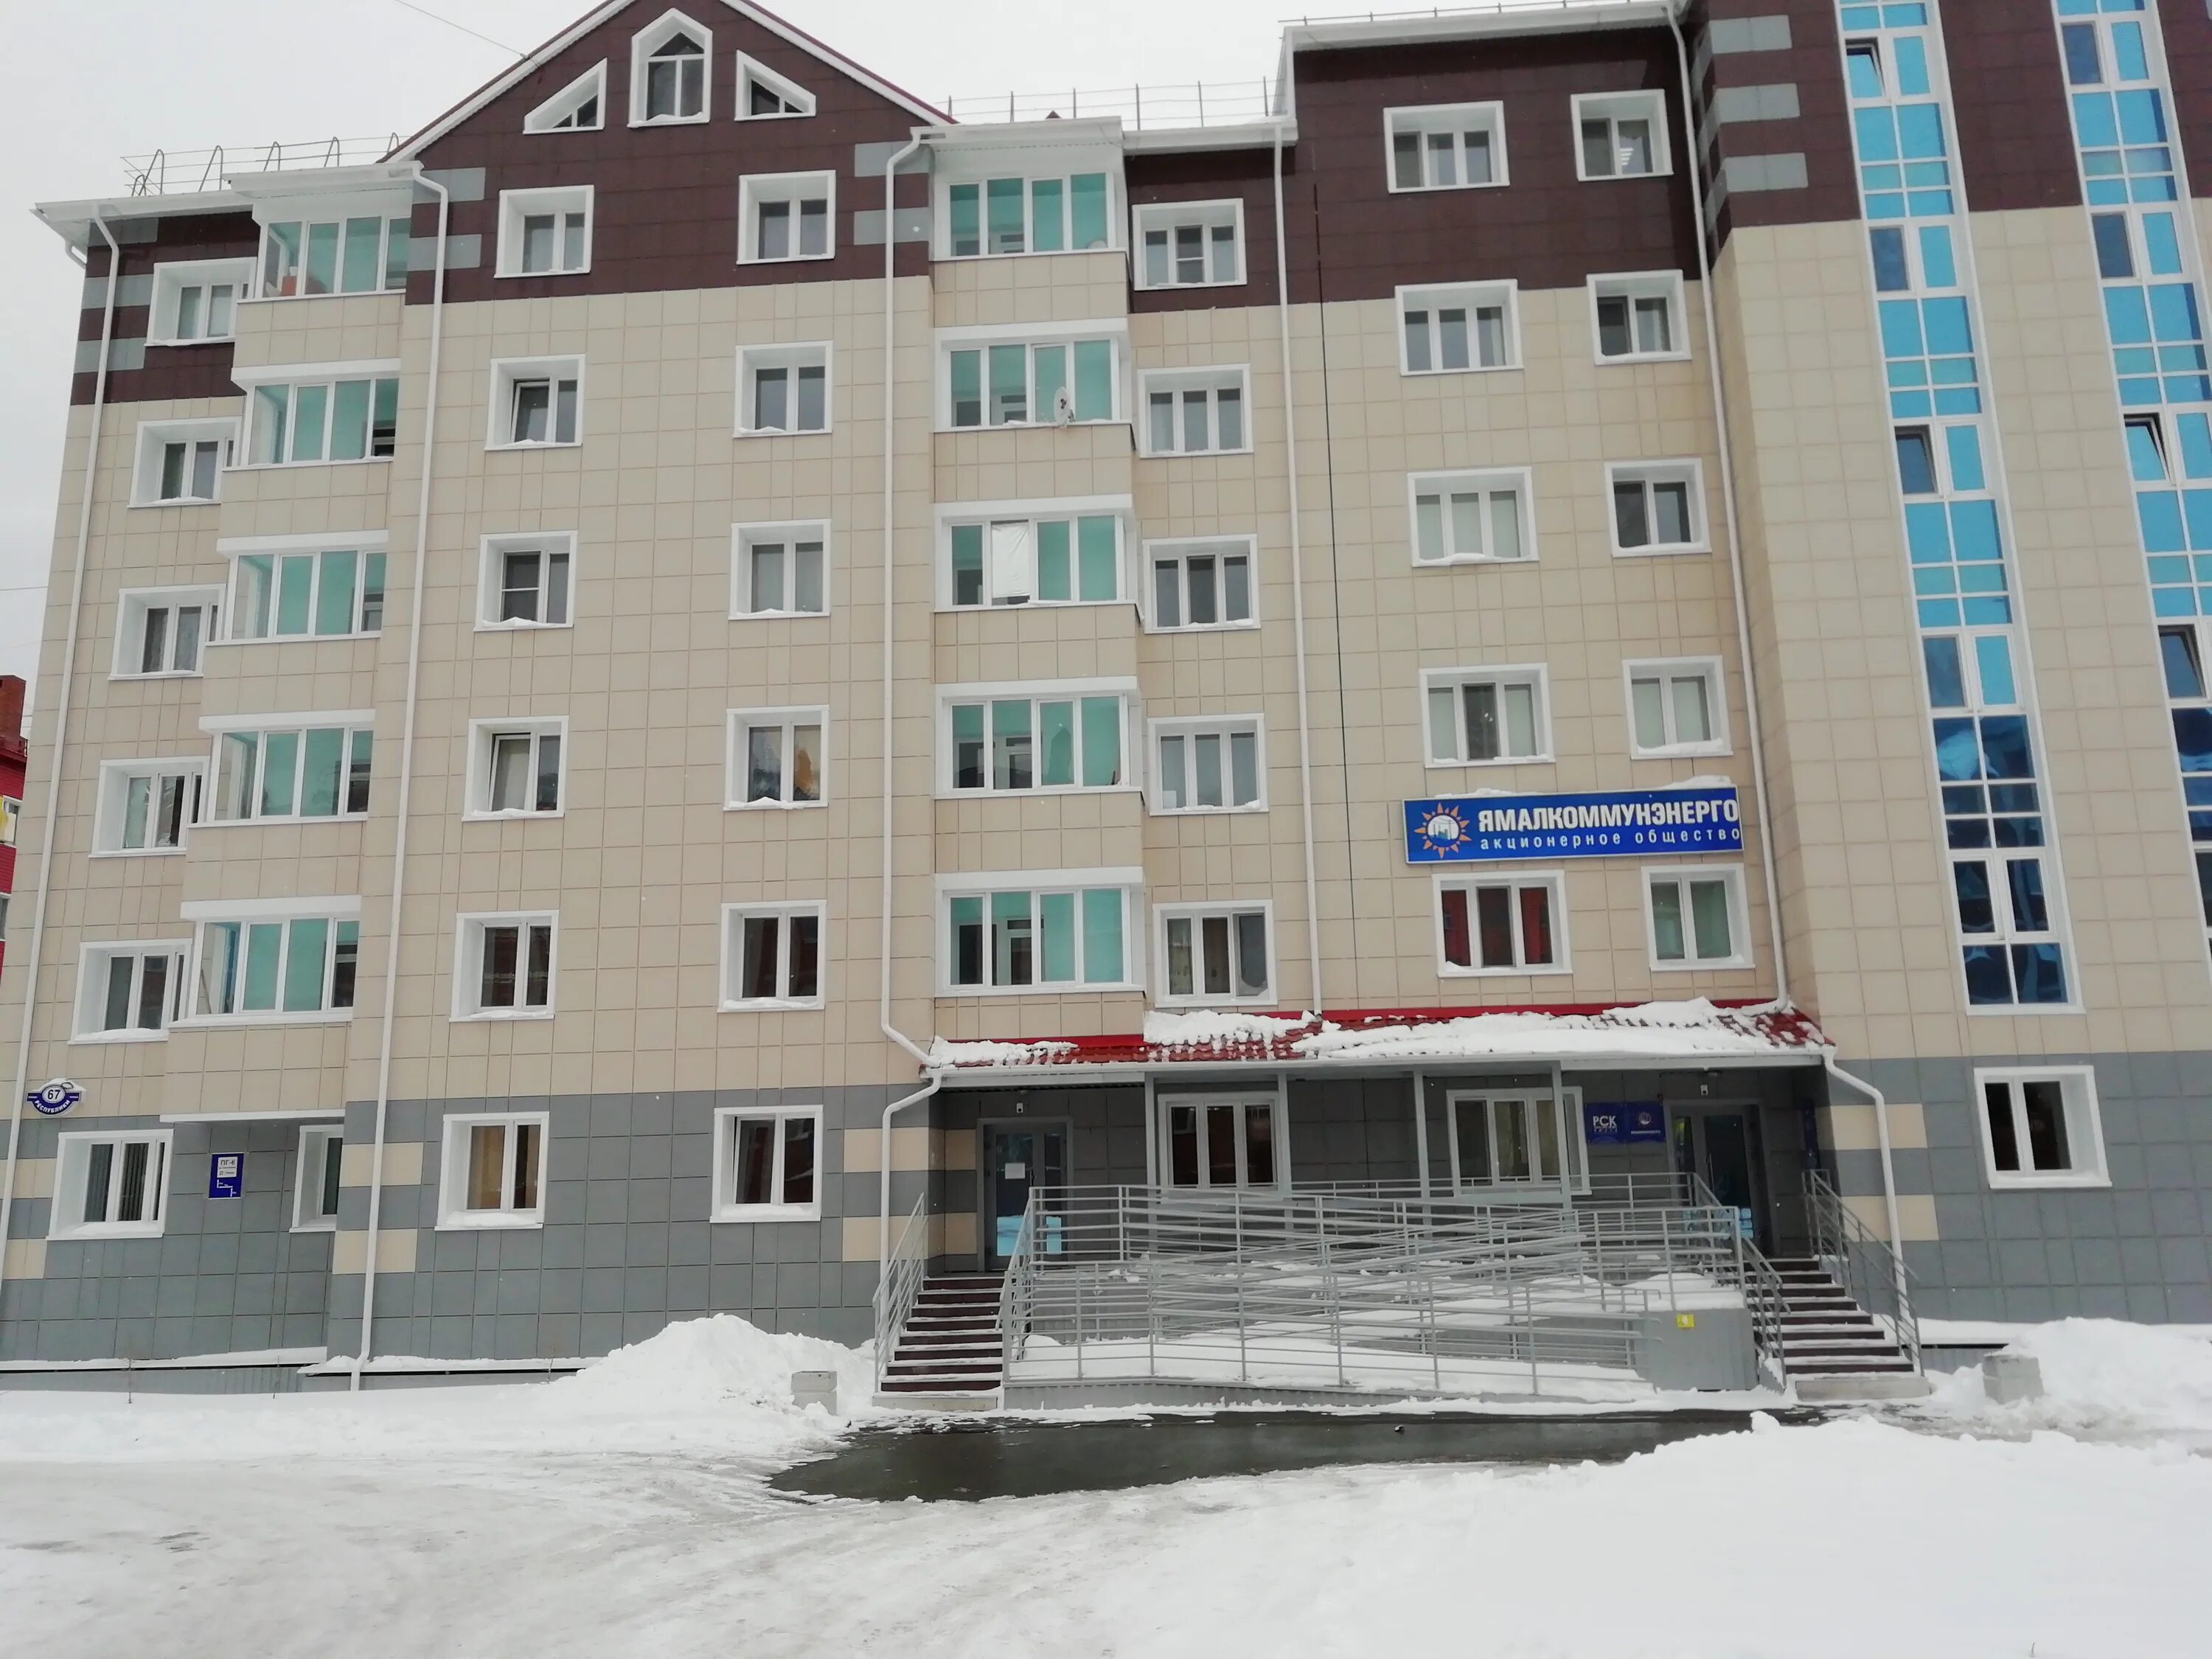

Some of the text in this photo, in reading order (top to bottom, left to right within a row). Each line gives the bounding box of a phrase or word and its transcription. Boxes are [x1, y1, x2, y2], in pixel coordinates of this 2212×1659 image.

[1478, 799, 1739, 832] ЯМАЛКОММУНЭНЕРГО
[1481, 828, 1741, 850] акционерное общество
[47, 1089, 60, 1099] 67
[35, 1099, 70, 1113] РЕСПУБЛИКИ
[1593, 1115, 1617, 1127] РСК
